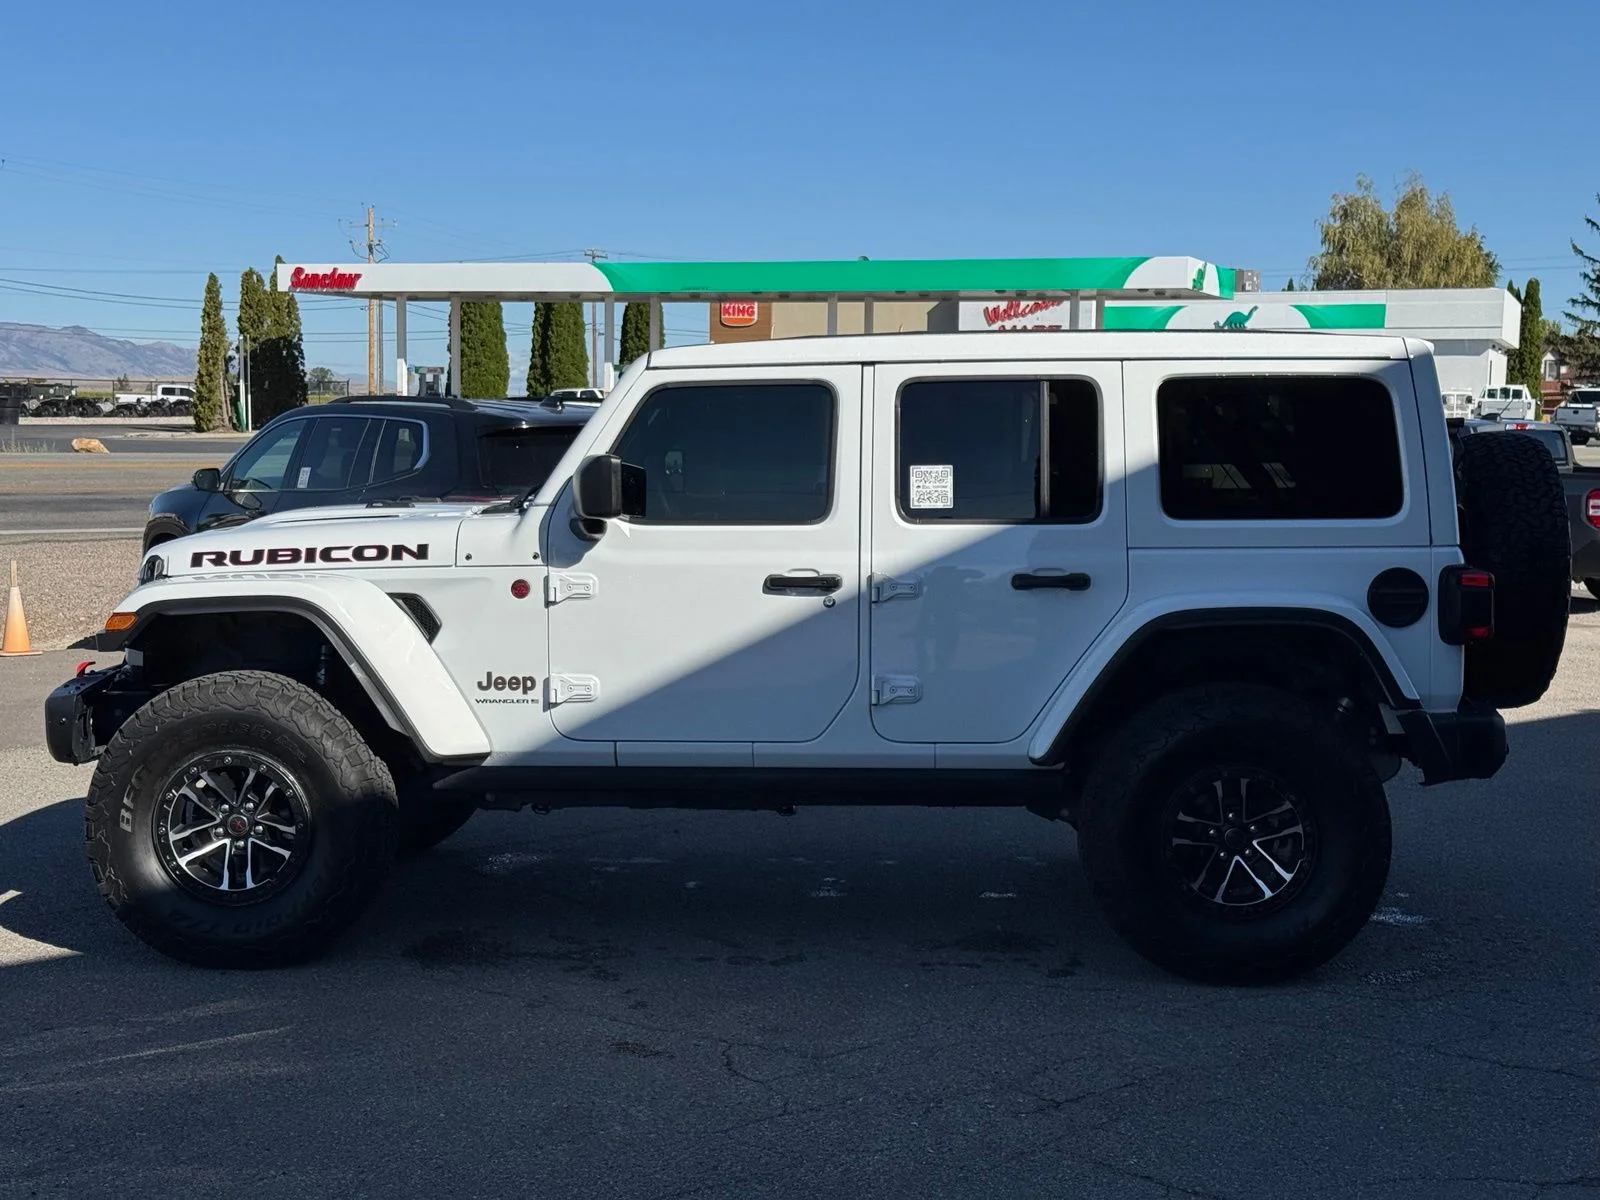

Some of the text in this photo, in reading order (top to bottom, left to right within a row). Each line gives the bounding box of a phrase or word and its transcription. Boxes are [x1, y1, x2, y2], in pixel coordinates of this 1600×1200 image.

[722, 305, 756, 317] KING
[190, 543, 429, 568] RUBICON
[477, 671, 536, 695] Jeep
